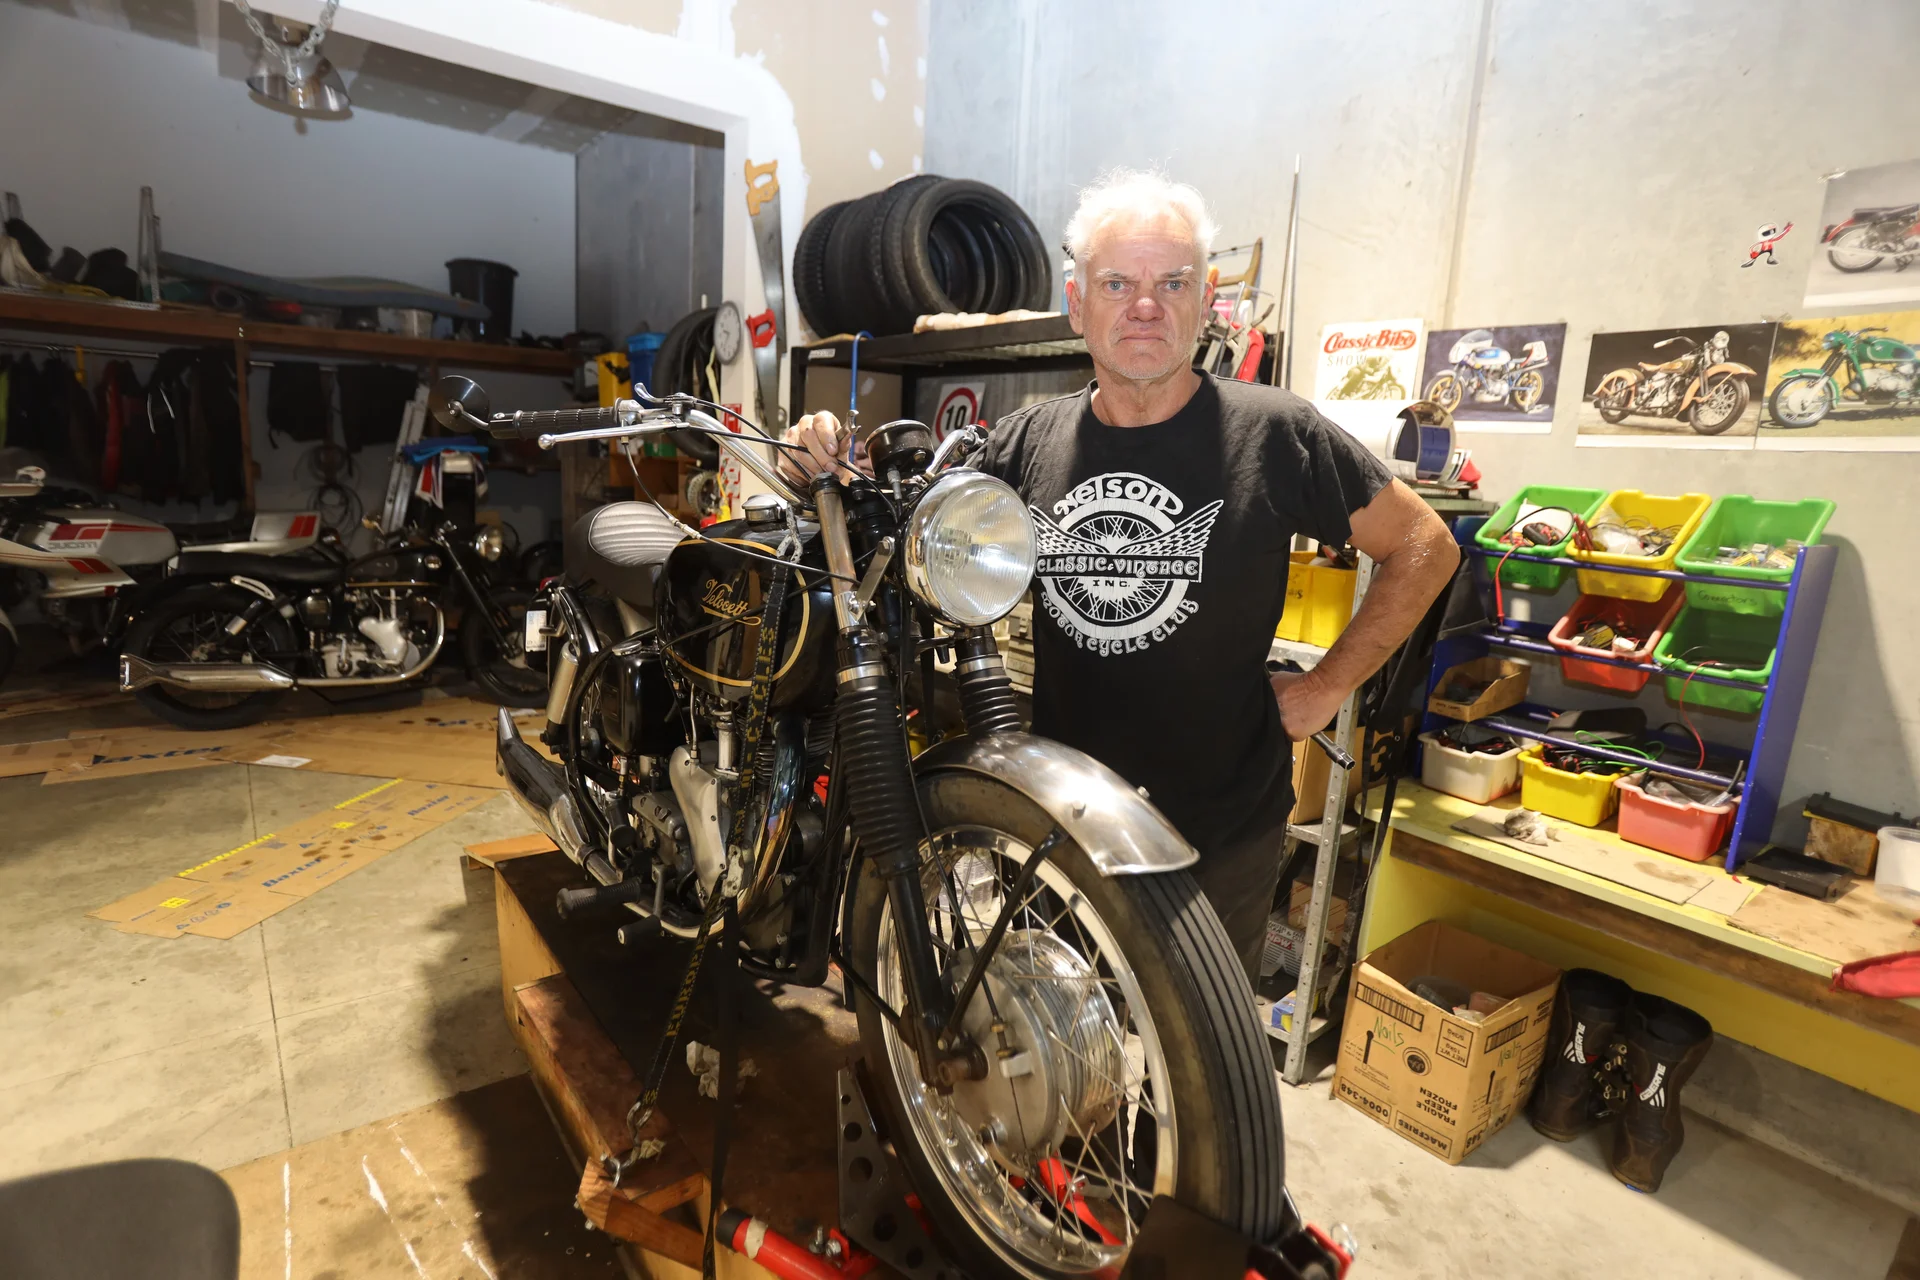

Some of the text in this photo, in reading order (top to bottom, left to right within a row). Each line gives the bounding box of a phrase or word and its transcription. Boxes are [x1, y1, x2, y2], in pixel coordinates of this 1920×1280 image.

[1326, 355, 1367, 367] SHOW
[945, 404, 968, 431] 10
[701, 579, 752, 617] Velocett
[1152, 598, 1200, 643] CLUB
[1374, 1016, 1404, 1047] Nails
[1341, 1083, 1389, 1118] 0004-348
[1416, 1100, 1456, 1126] FRAGILE
[1420, 1087, 1458, 1111] FROZEN
[1424, 1099, 1450, 1115] KEEP
[1398, 1119, 1448, 1151] MACFRIES
